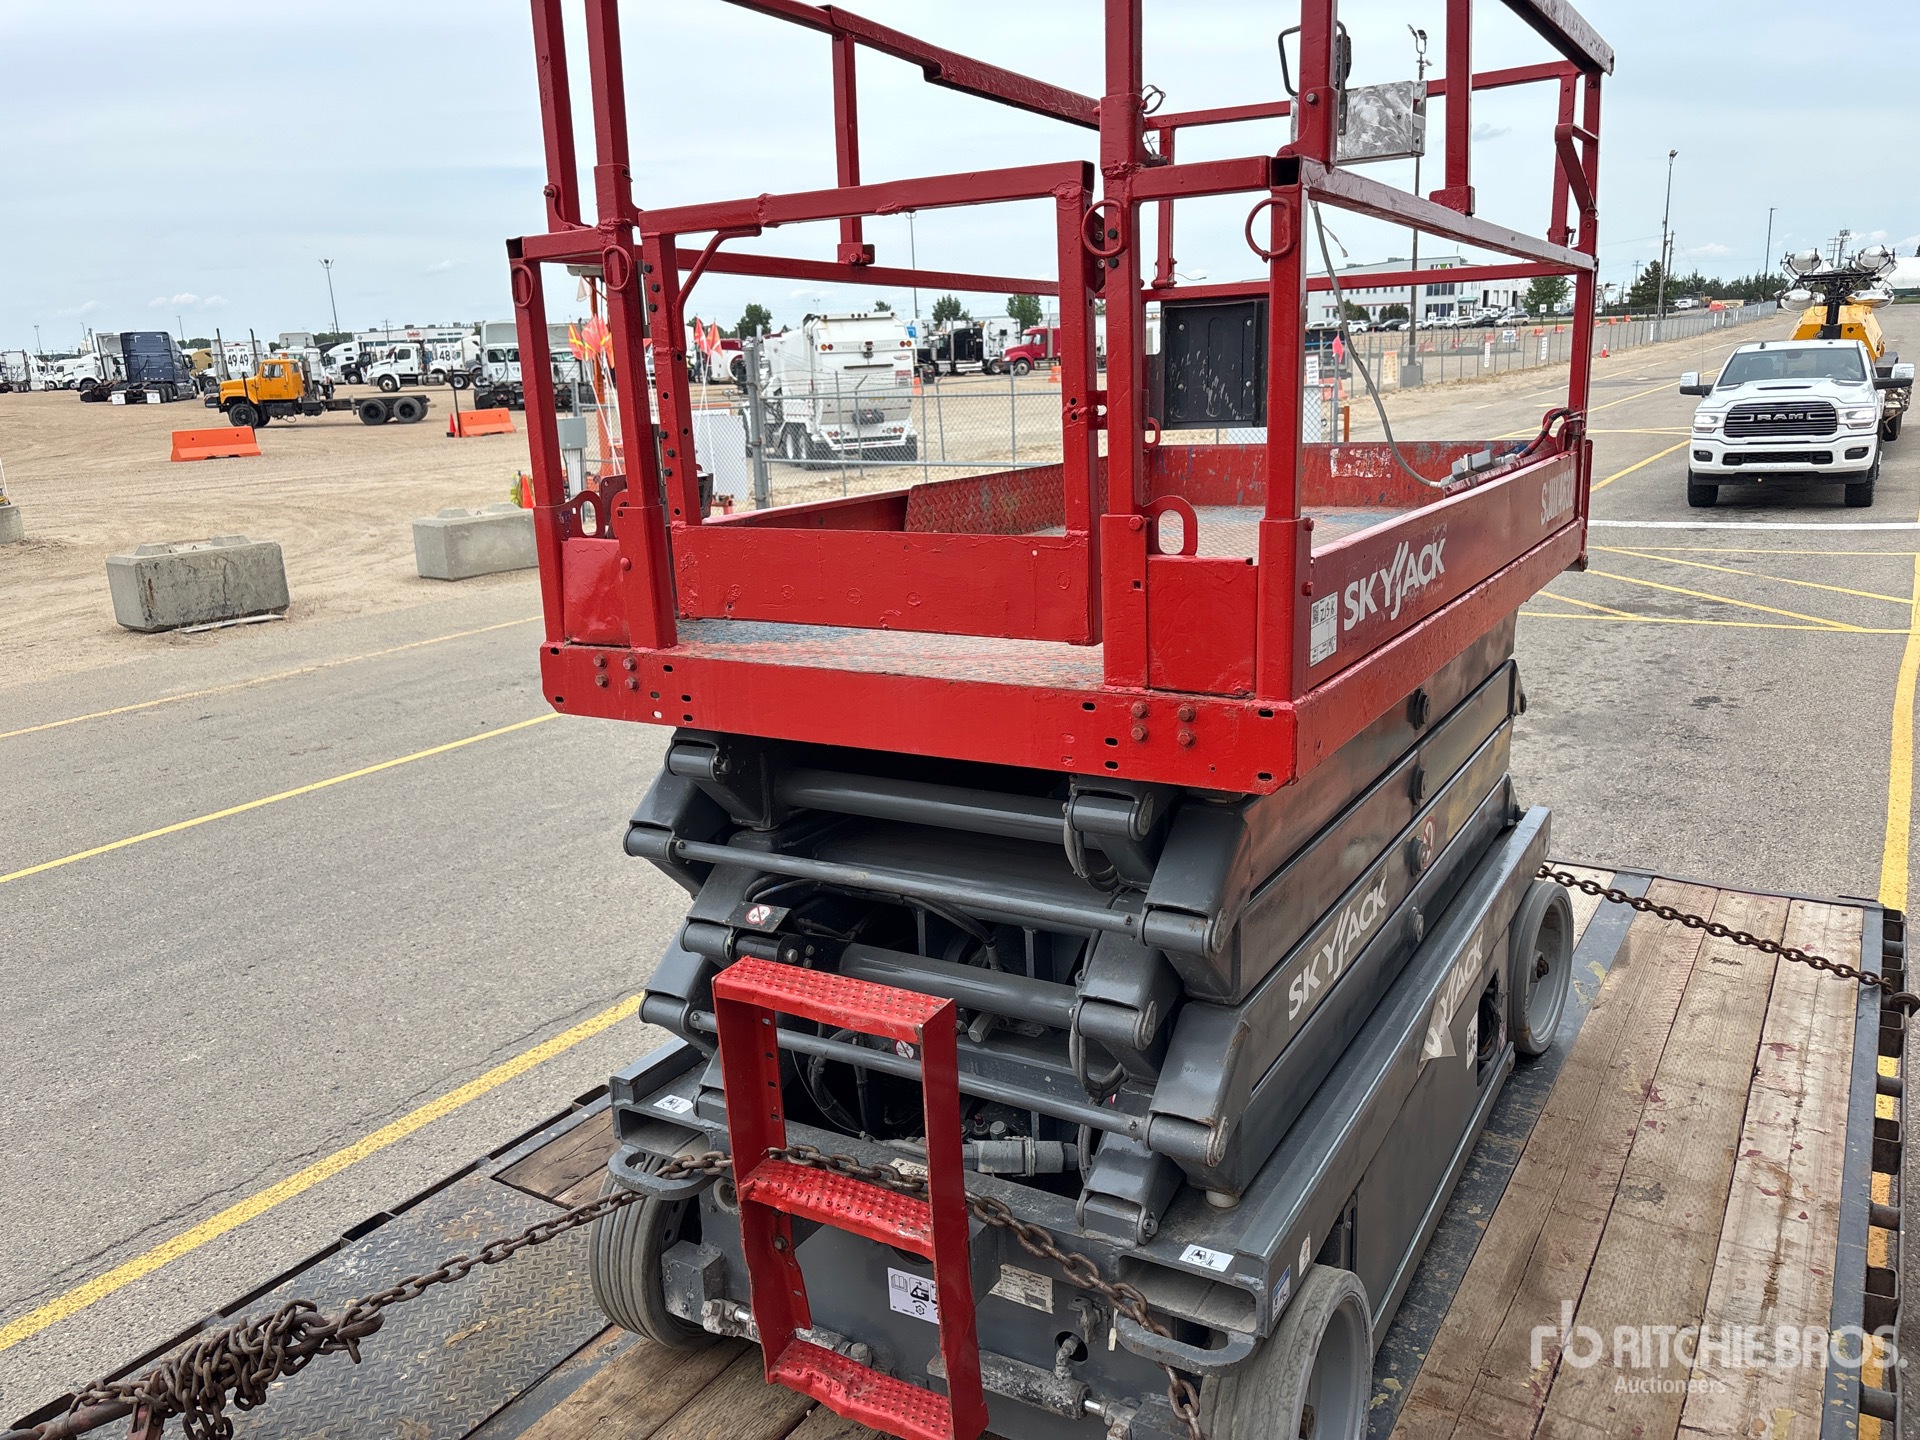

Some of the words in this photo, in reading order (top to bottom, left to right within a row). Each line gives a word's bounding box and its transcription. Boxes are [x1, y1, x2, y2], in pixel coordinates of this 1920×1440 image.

[228, 354, 238, 367] 49
[240, 354, 249, 366] 49
[440, 350, 451, 361] 48
[1757, 412, 1804, 421] RAM
[1344, 538, 1446, 631] SKYJACK
[1288, 877, 1387, 1021] SKYJACK
